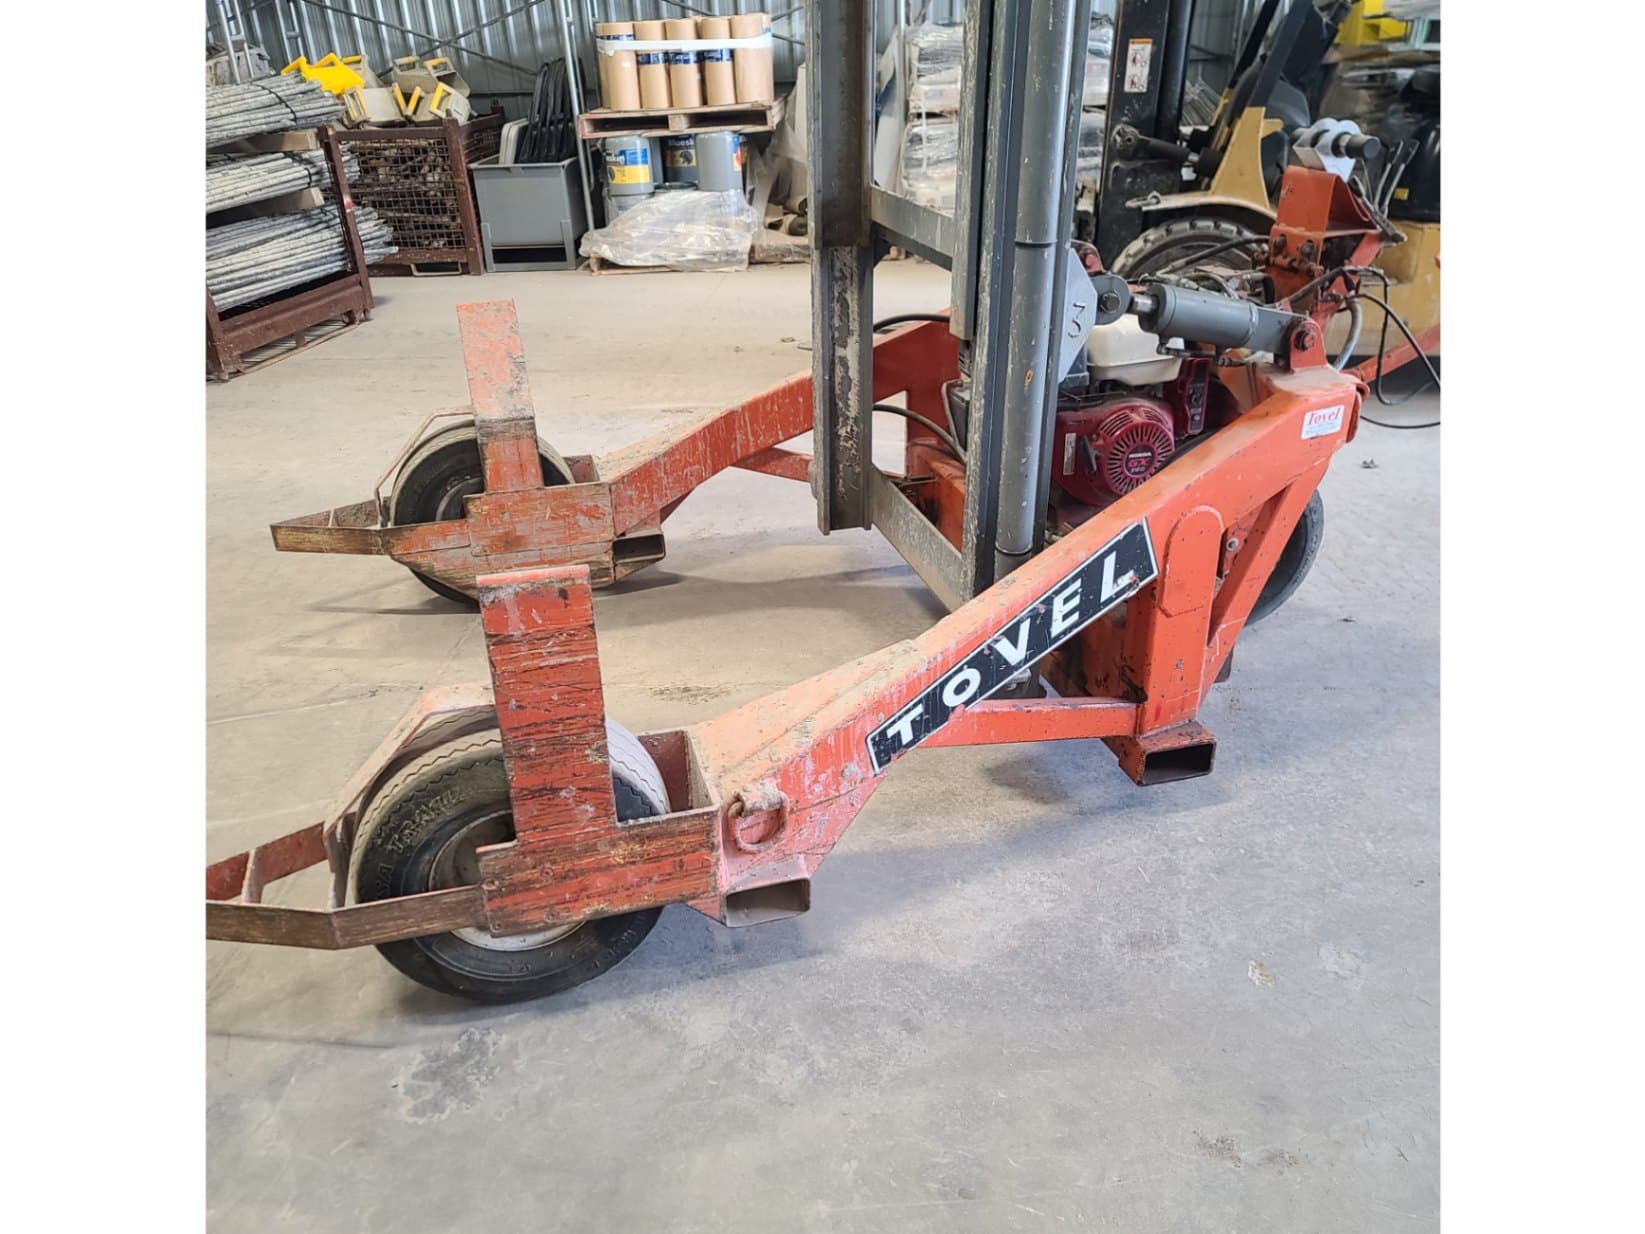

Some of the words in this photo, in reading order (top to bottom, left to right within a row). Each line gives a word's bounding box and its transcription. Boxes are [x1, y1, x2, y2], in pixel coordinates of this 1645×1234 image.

[1068, 303, 1086, 338] 3
[1306, 407, 1341, 425] Tovel
[1128, 458, 1150, 468] GX
[886, 551, 1135, 747] TOVEL
